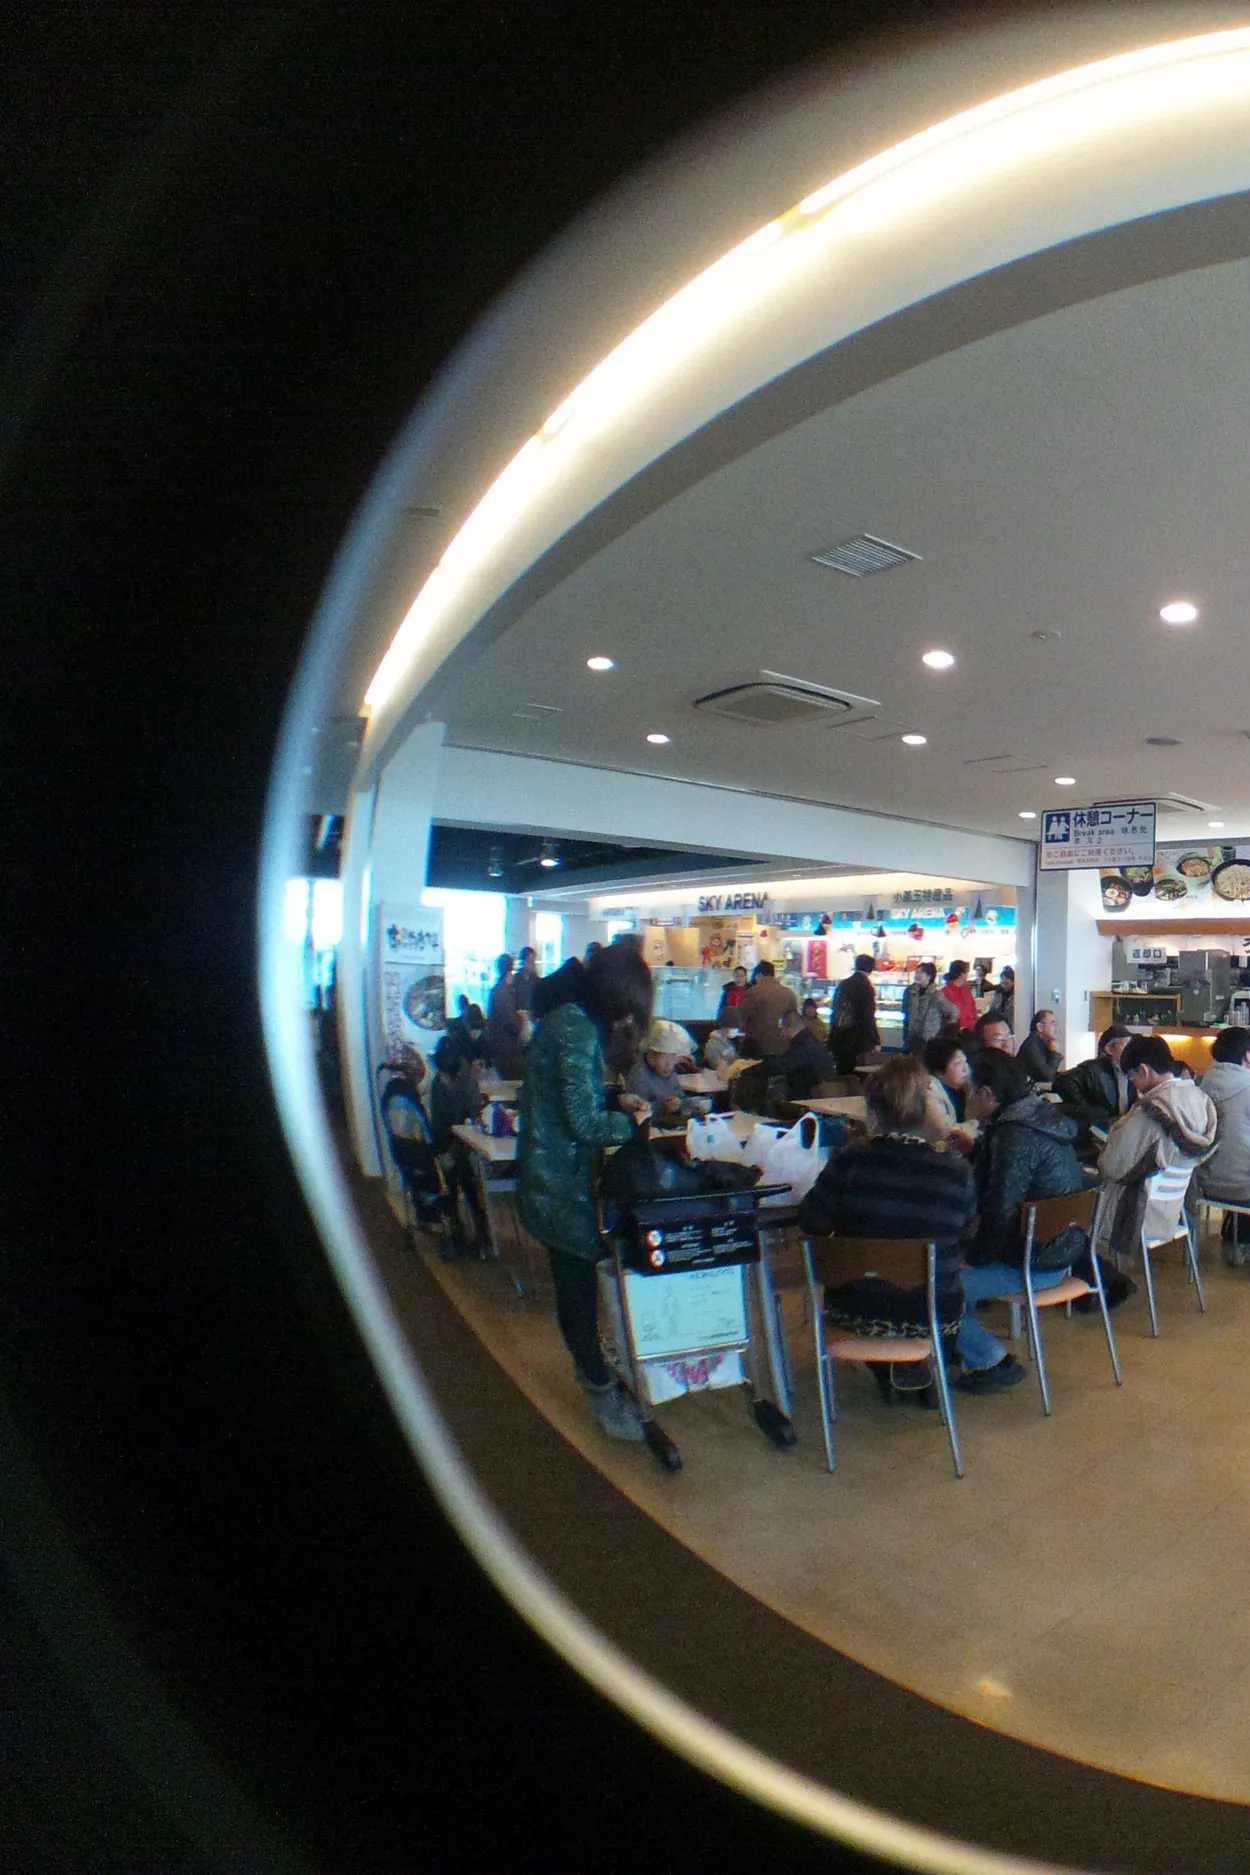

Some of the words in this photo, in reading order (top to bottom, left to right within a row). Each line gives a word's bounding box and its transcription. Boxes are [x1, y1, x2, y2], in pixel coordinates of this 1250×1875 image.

[1073, 808, 1153, 828] 休憩コーナー
[1074, 829, 1095, 837] Break
[698, 896, 720, 911] SKY
[725, 892, 769, 910] ARENA
[1132, 948, 1162, 958] 返却口
